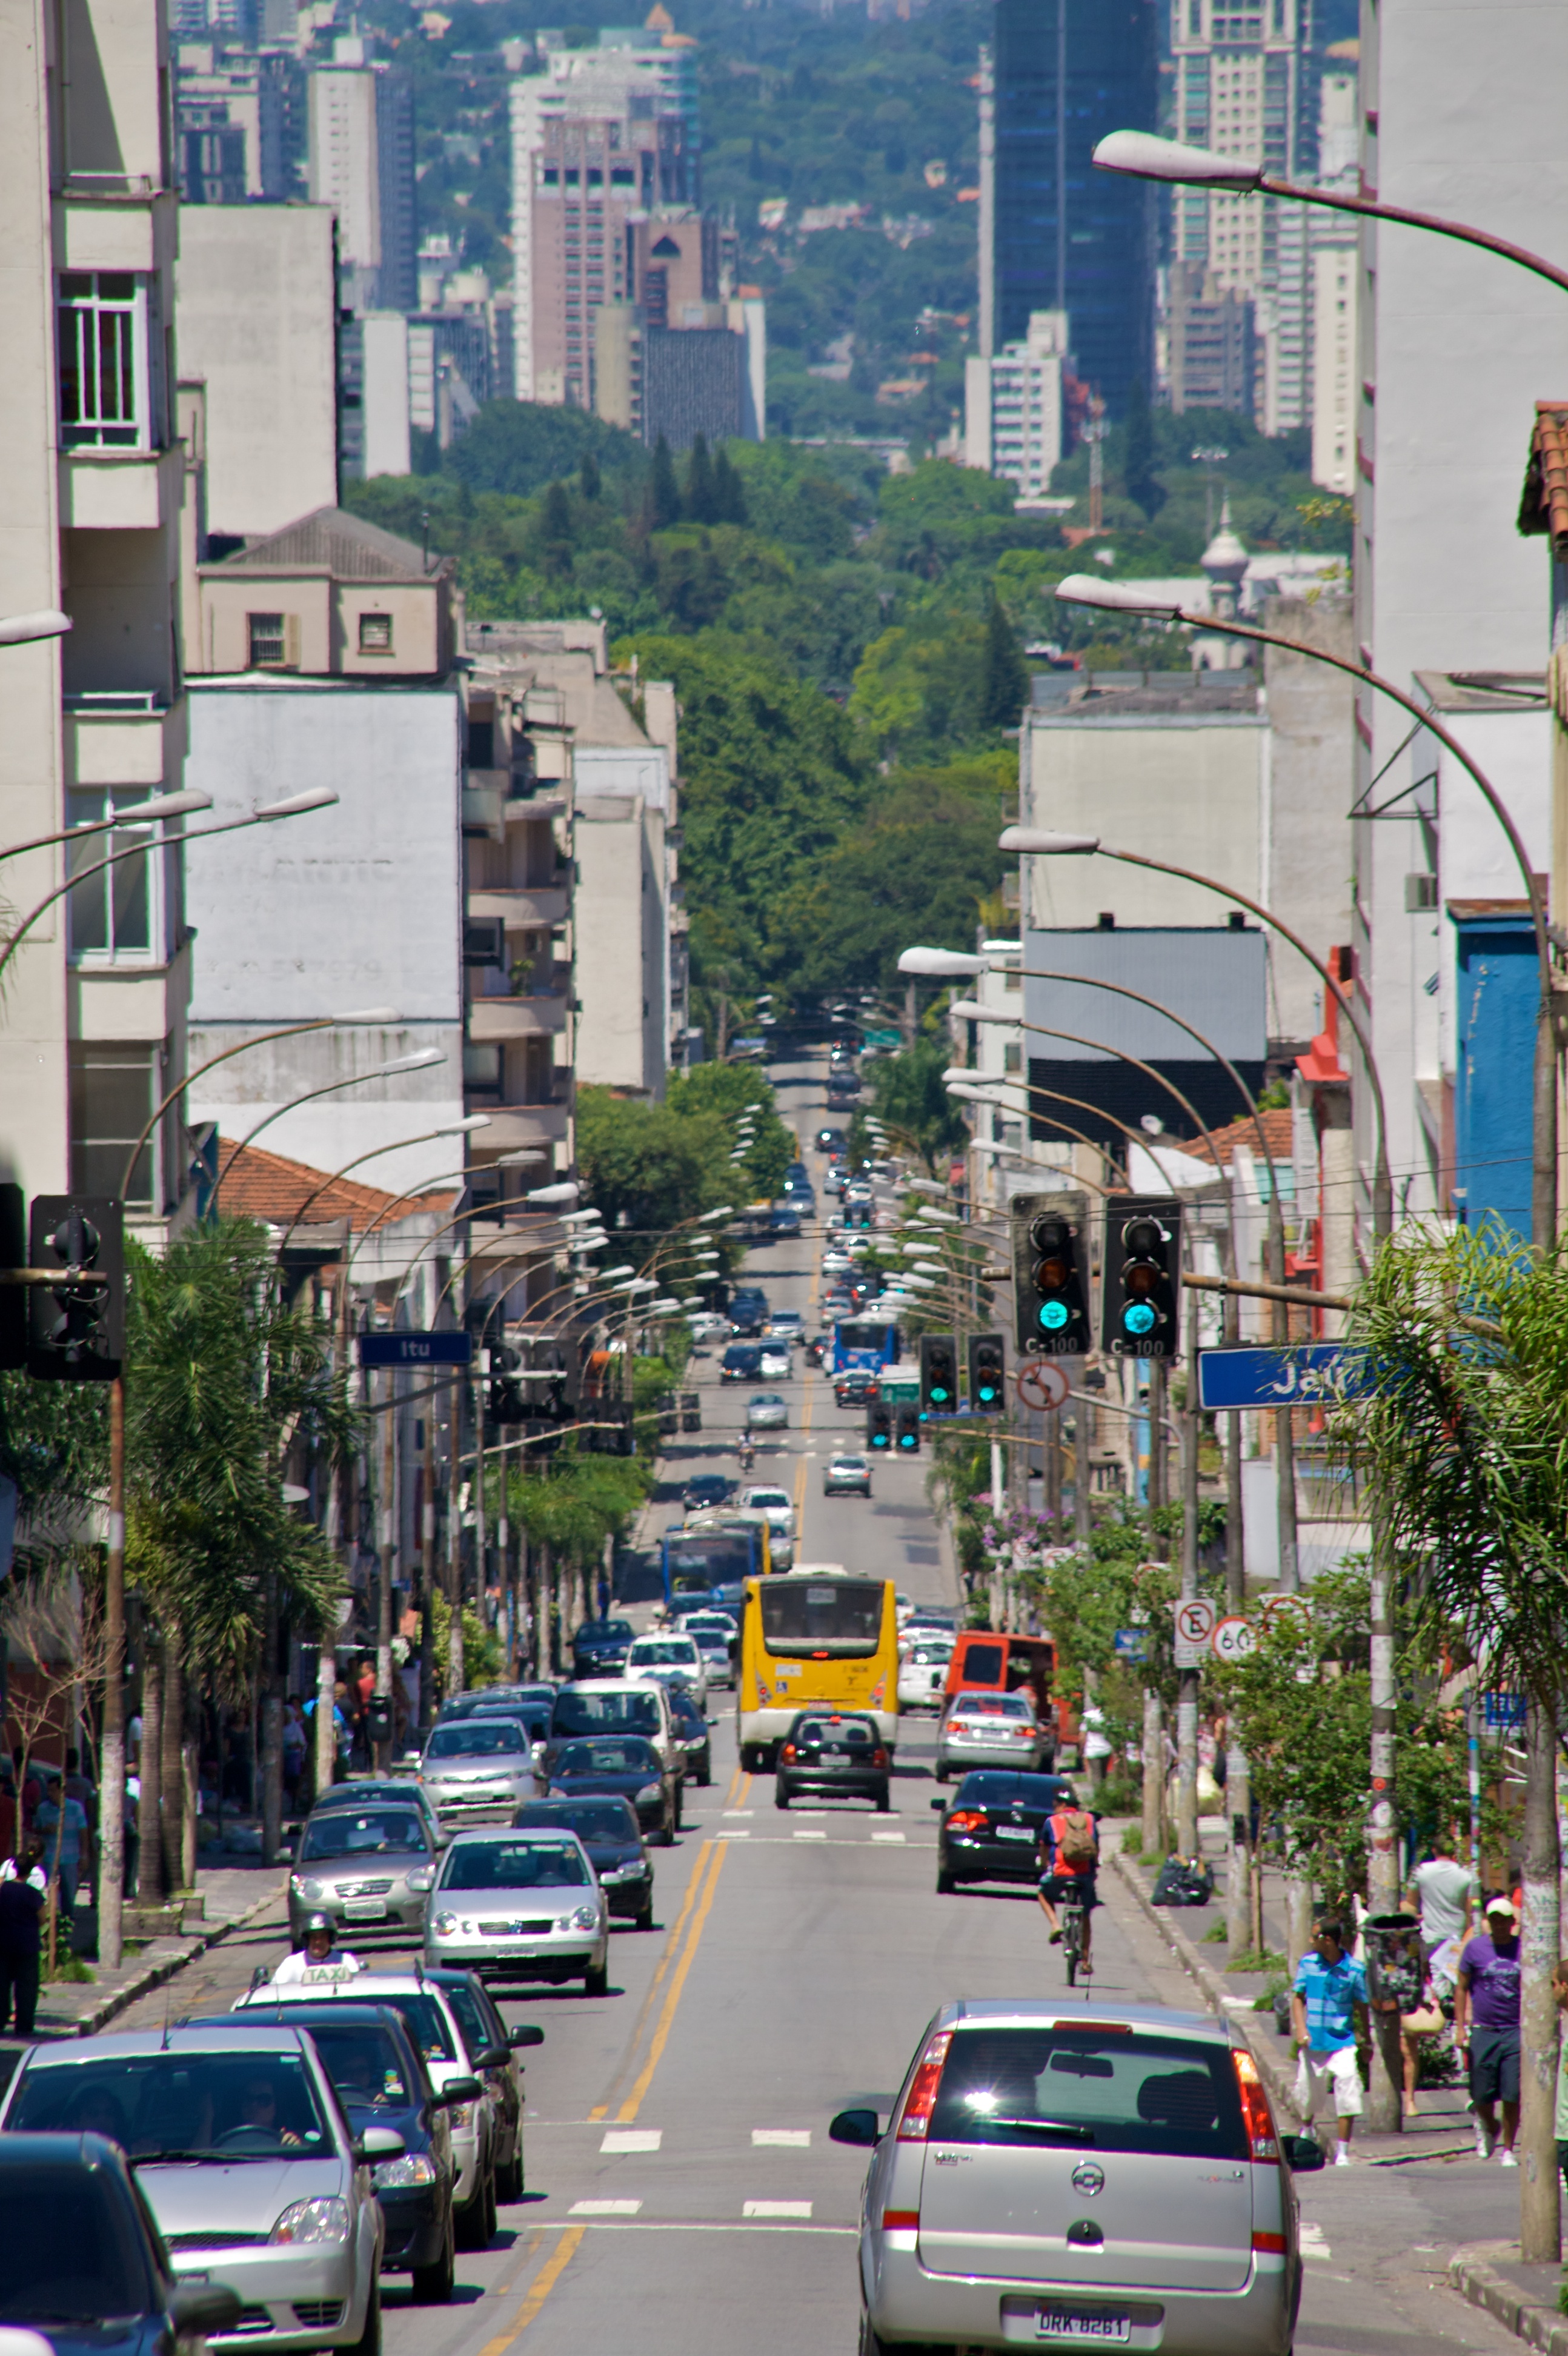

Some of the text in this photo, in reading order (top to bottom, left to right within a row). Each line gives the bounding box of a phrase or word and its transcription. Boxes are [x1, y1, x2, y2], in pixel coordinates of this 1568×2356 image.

[400, 1340, 430, 1357] Itu
[1025, 1337, 1078, 1353] C-100
[1110, 1338, 1164, 1355] C-100
[307, 1966, 347, 1982] TAXI
